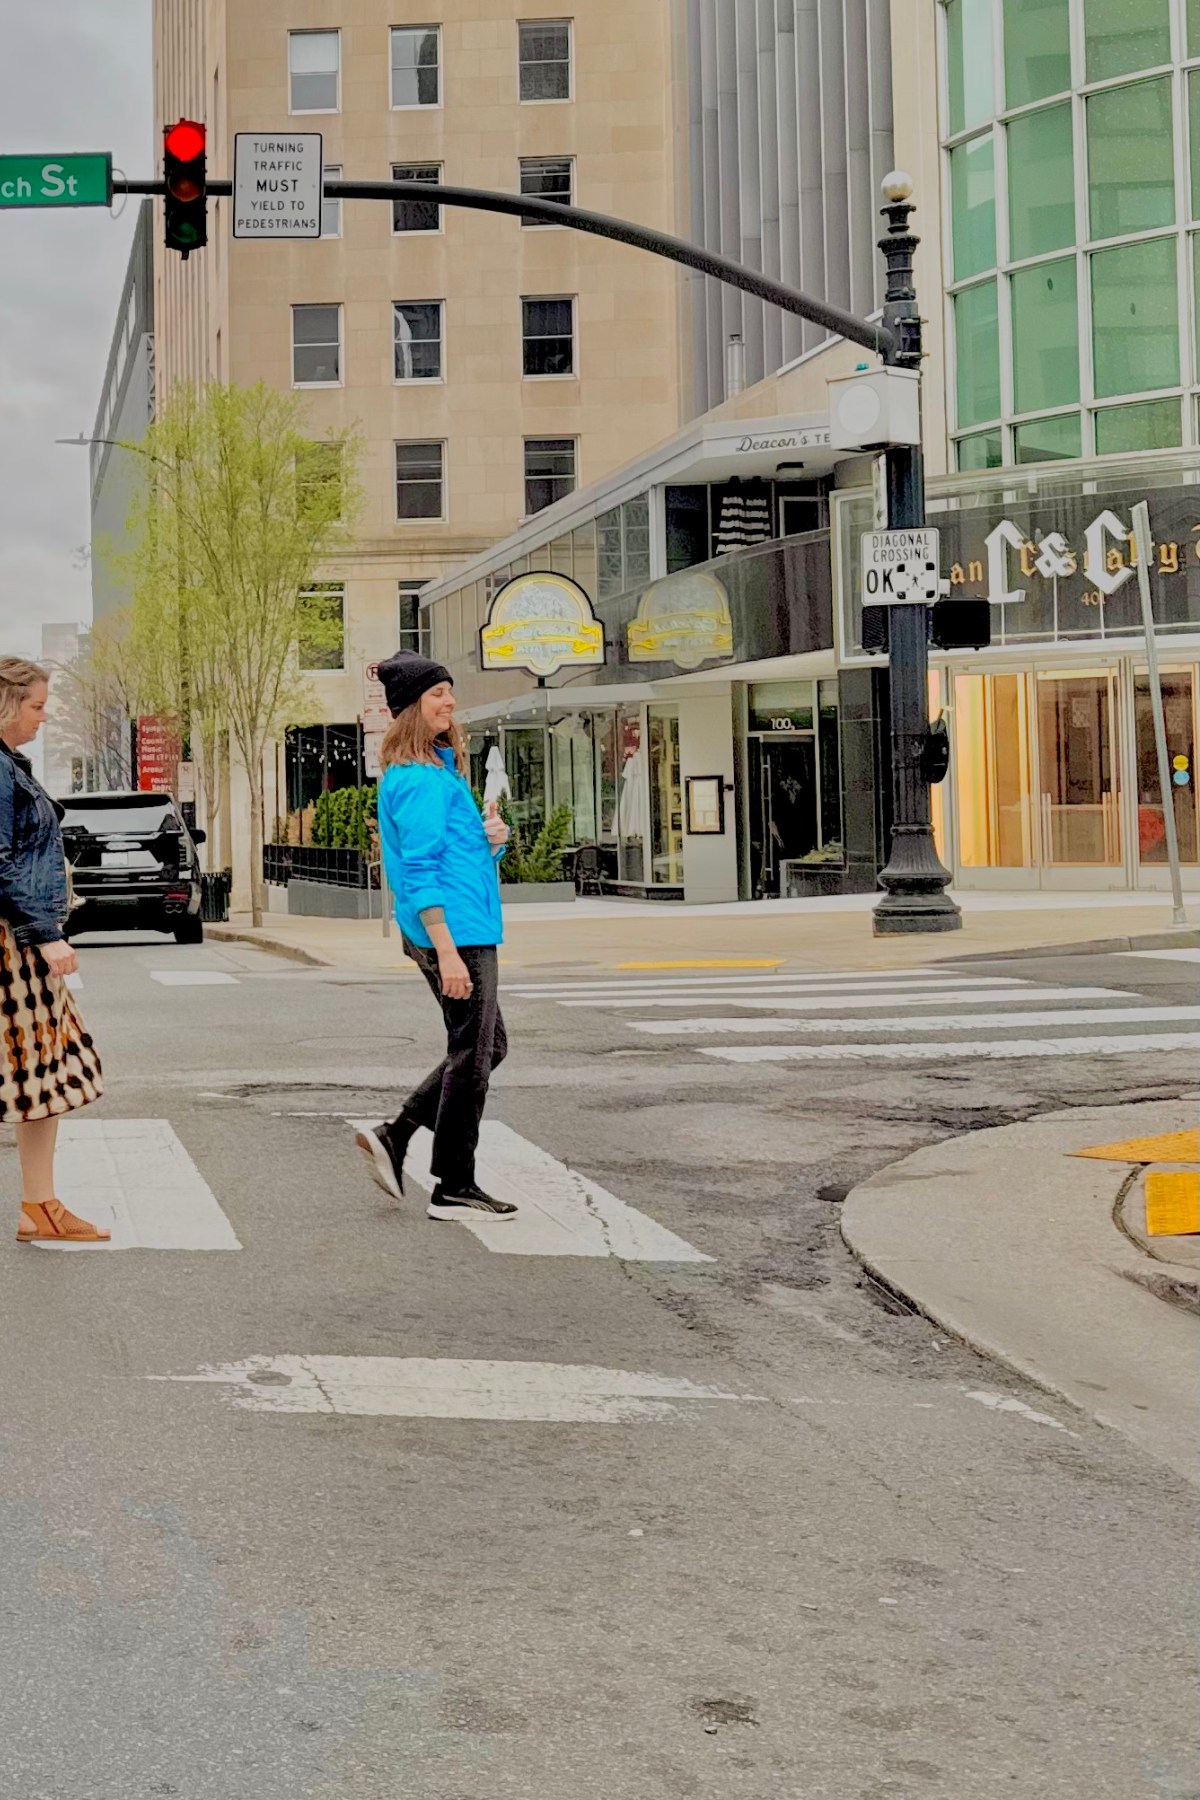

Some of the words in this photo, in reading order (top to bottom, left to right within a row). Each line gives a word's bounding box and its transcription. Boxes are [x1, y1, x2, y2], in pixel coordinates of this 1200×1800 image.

[253, 142, 304, 153] TURNING
[254, 160, 303, 171] TRAFFIC
[40, 164, 78, 197] St
[256, 179, 298, 192] MUST
[250, 200, 285, 211] YIELD
[290, 200, 305, 211] TO
[237, 218, 317, 229] PEDESTRIANS
[736, 431, 808, 452] Deacon's
[872, 533, 930, 549] DIAGONAL
[873, 546, 929, 563] CROSSING
[866, 568, 894, 594] OK
